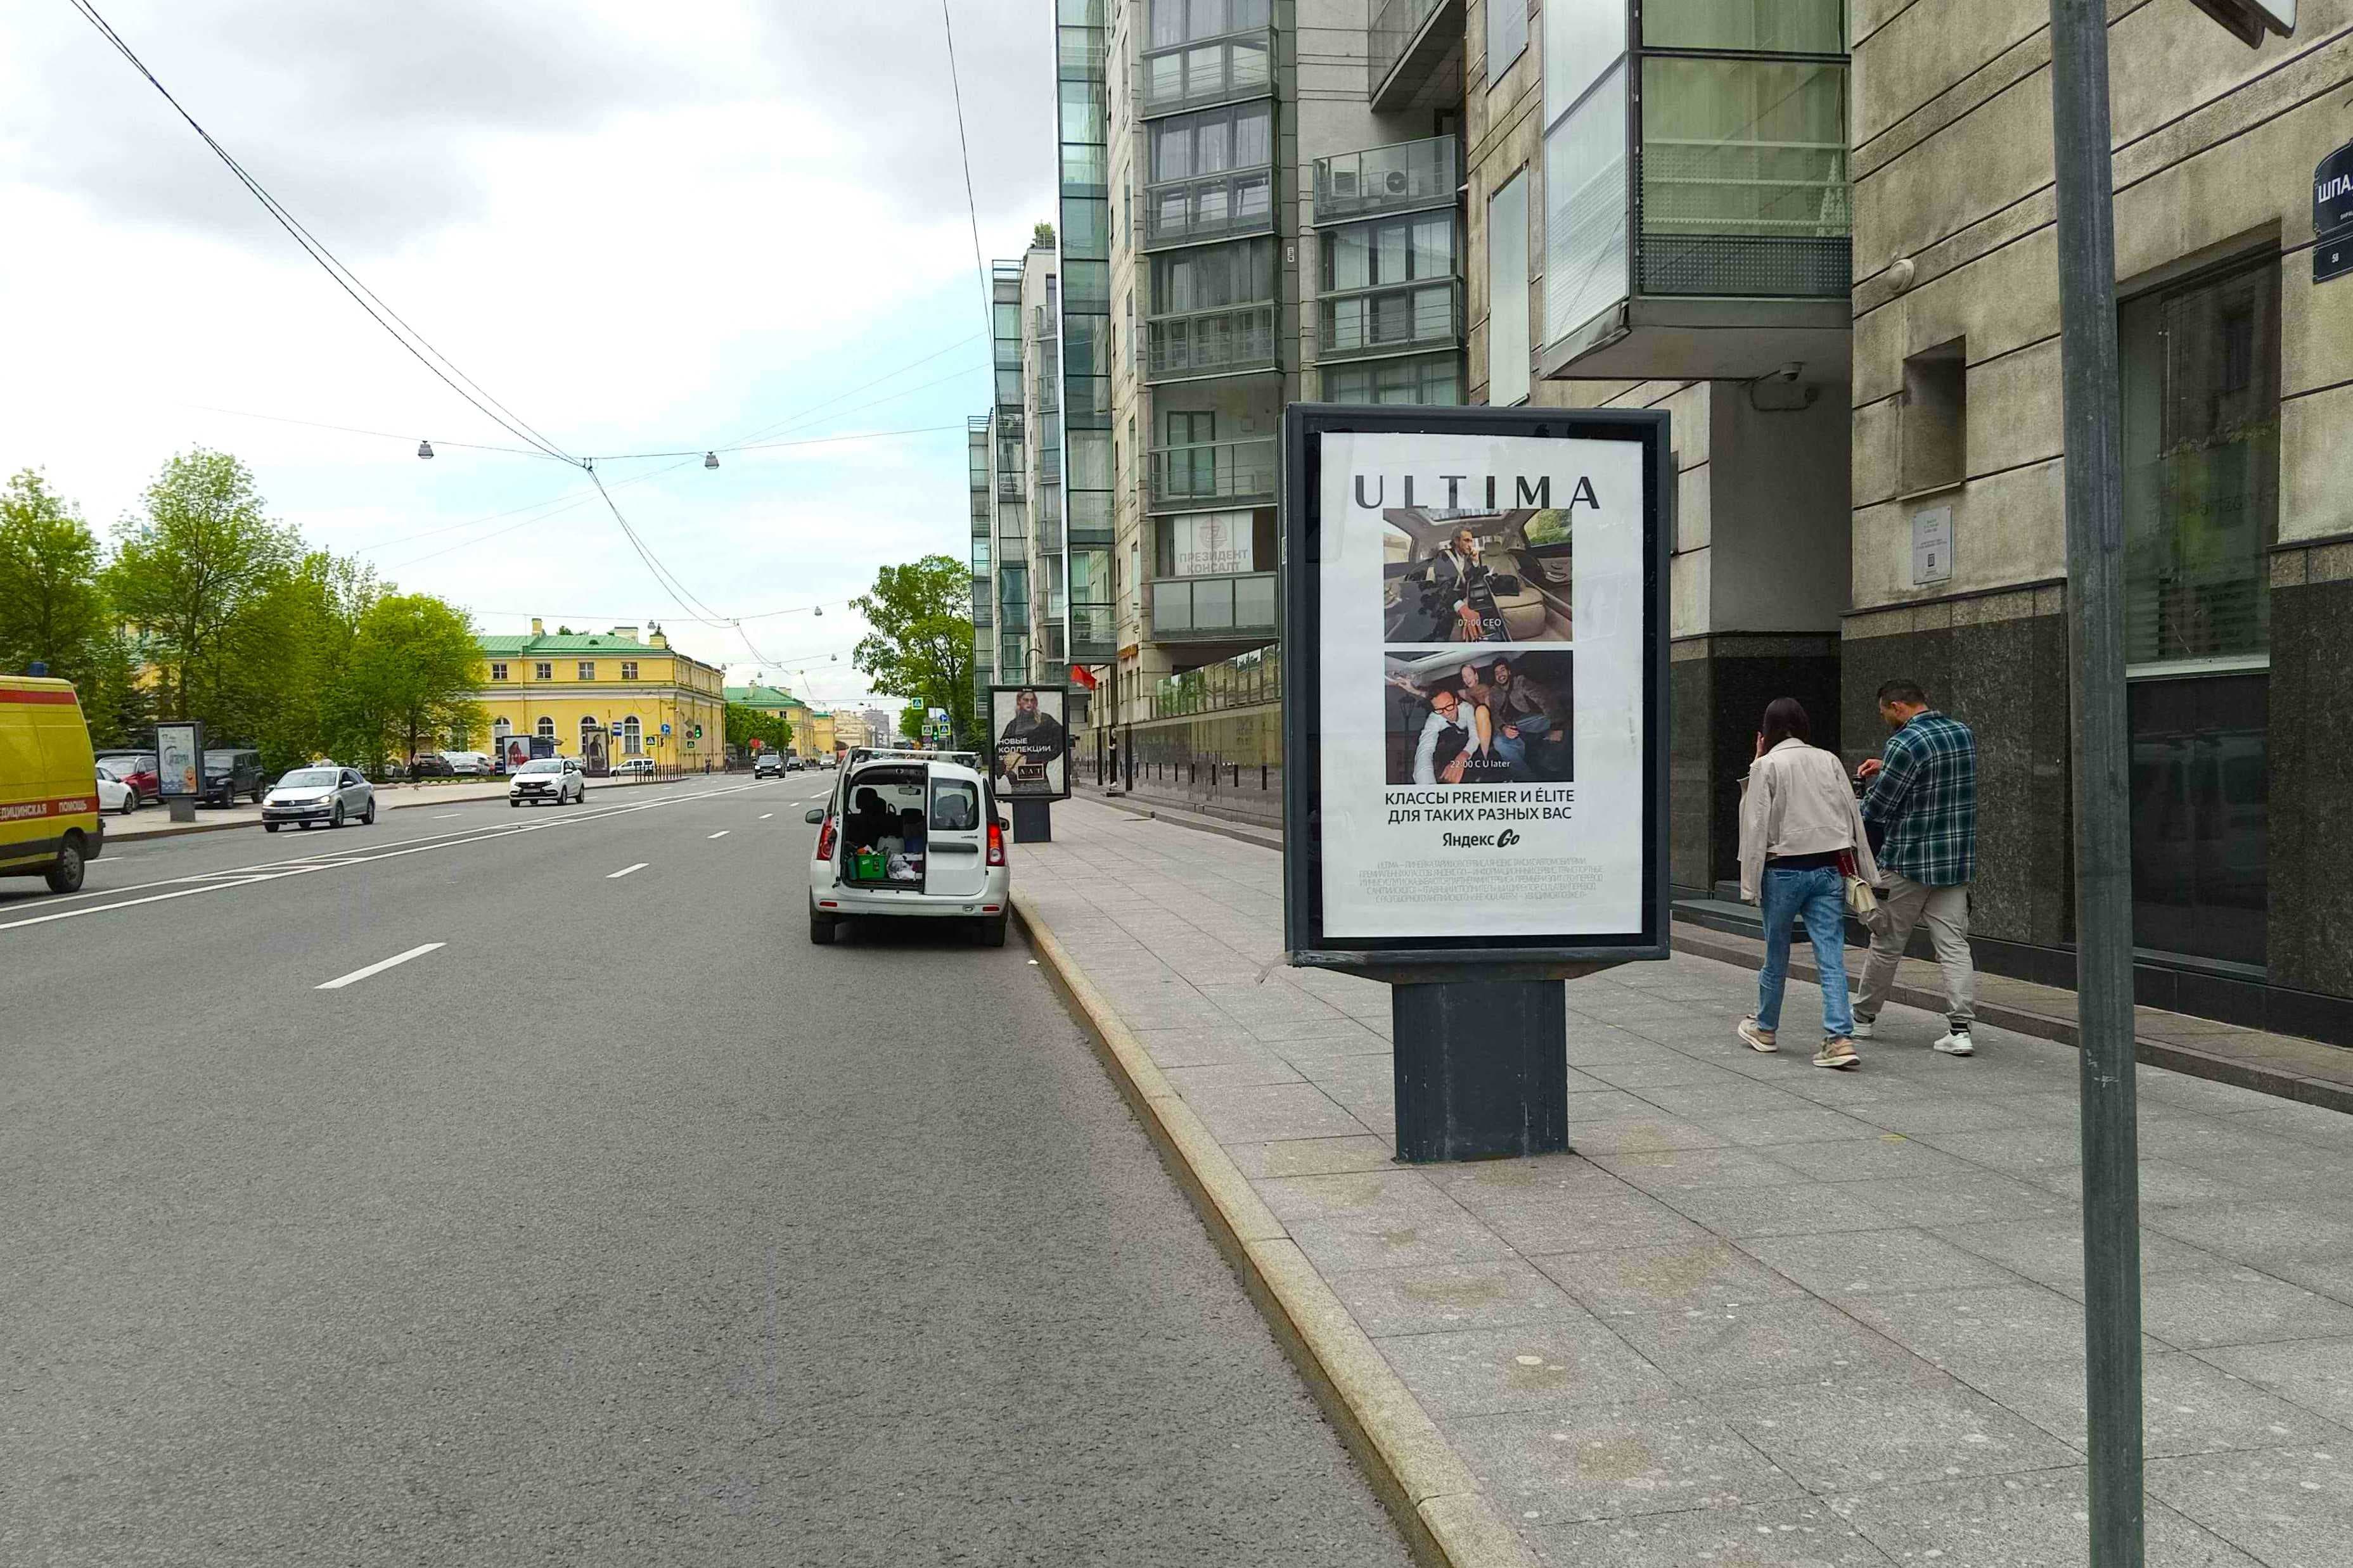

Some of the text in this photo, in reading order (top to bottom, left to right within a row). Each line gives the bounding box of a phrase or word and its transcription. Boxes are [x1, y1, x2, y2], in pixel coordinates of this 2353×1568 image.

[2318, 174, 2353, 203] ШПА
[1355, 475, 1600, 509] ULTIMA
[1179, 549, 1248, 563] ПРЕЗИДЕНТ
[1187, 562, 1241, 573] КОНСАЛТ
[1458, 618, 1502, 627] 07:00 CEO
[998, 745, 1052, 753] КОЛЛЕКЦИИ
[1450, 760, 1511, 768] 22:00 C U later
[1385, 787, 1575, 805] КЛАССЫ PREMIER И ÉLITE
[0, 800, 87, 820] ДИЦИНСКАЯ ПОМОЩЬ
[1388, 806, 1572, 825] ДЛЯ ТАКИХ РАЗНЫХ ВАС
[1442, 829, 1520, 848] Яндекс Go
